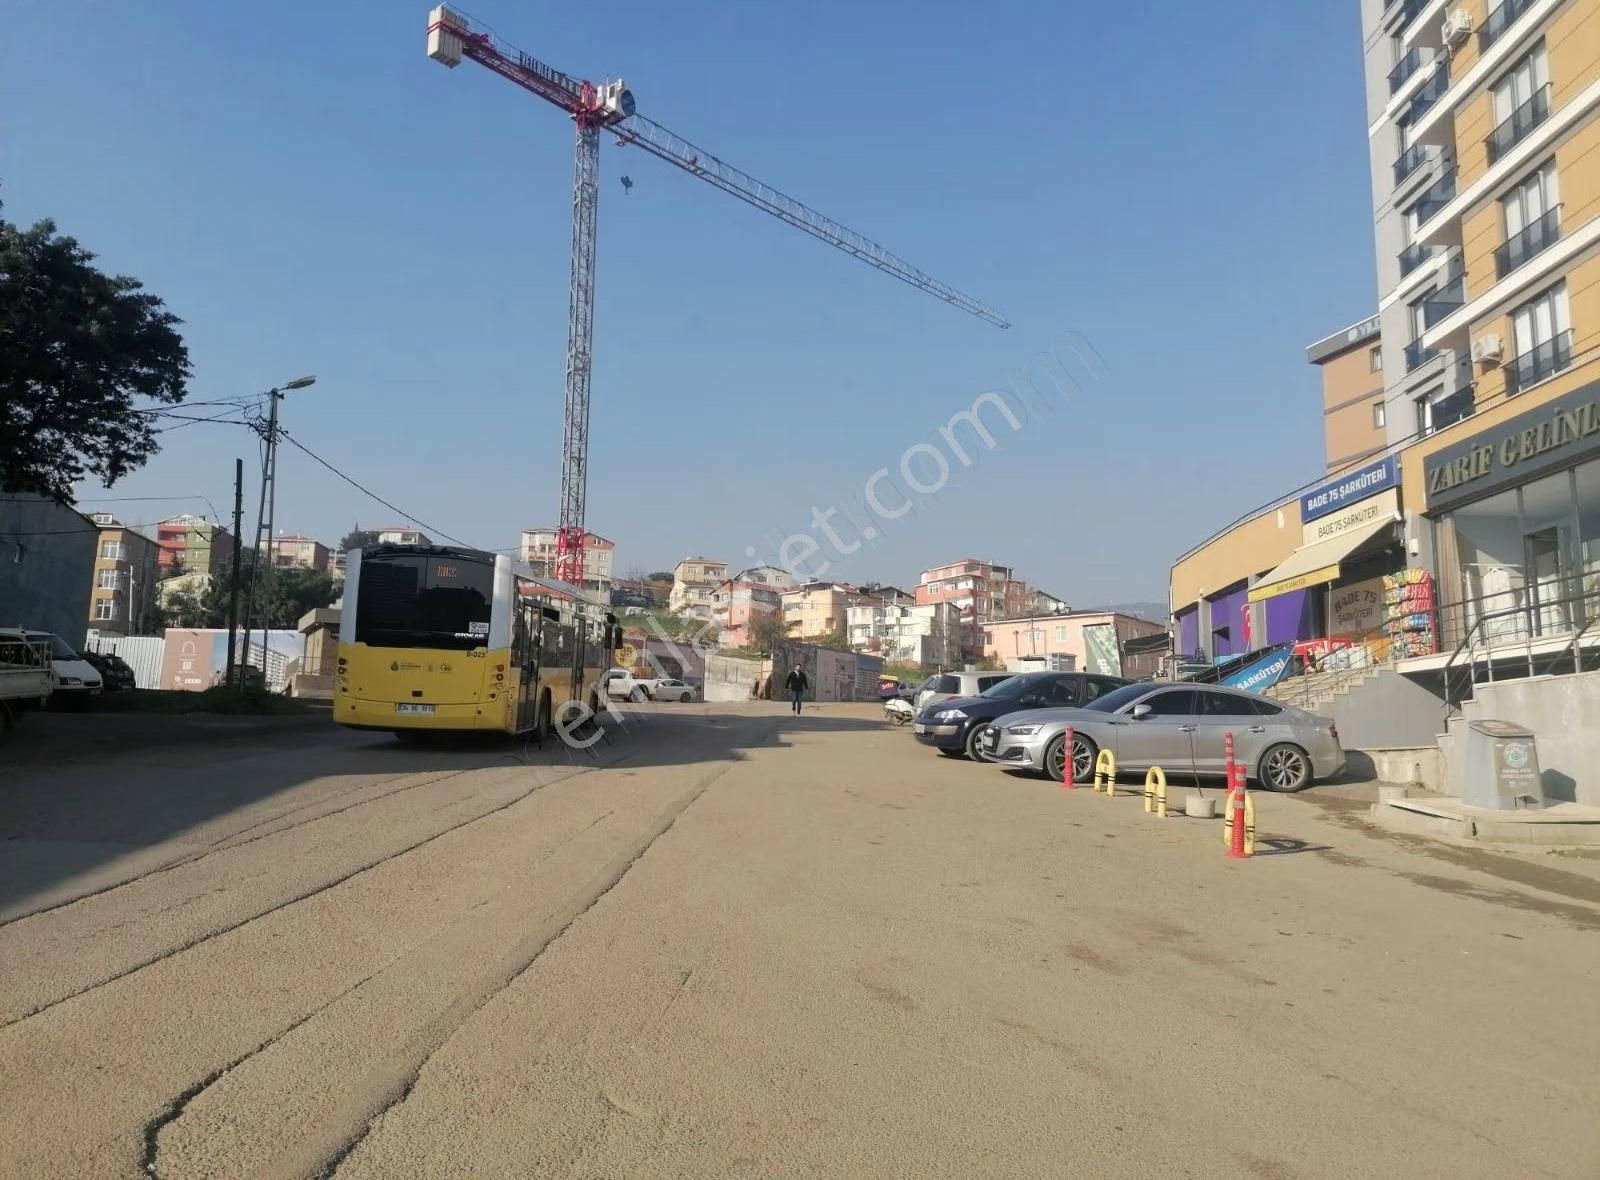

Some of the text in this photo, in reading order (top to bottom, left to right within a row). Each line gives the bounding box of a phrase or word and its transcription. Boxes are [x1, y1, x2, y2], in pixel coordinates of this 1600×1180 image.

[1431, 443, 1495, 496] ZARİF
[1307, 464, 1386, 511] BADE 75 ŞARKÜTERİ
[1318, 521, 1334, 537] BADE
[1363, 590, 1377, 603] 75
